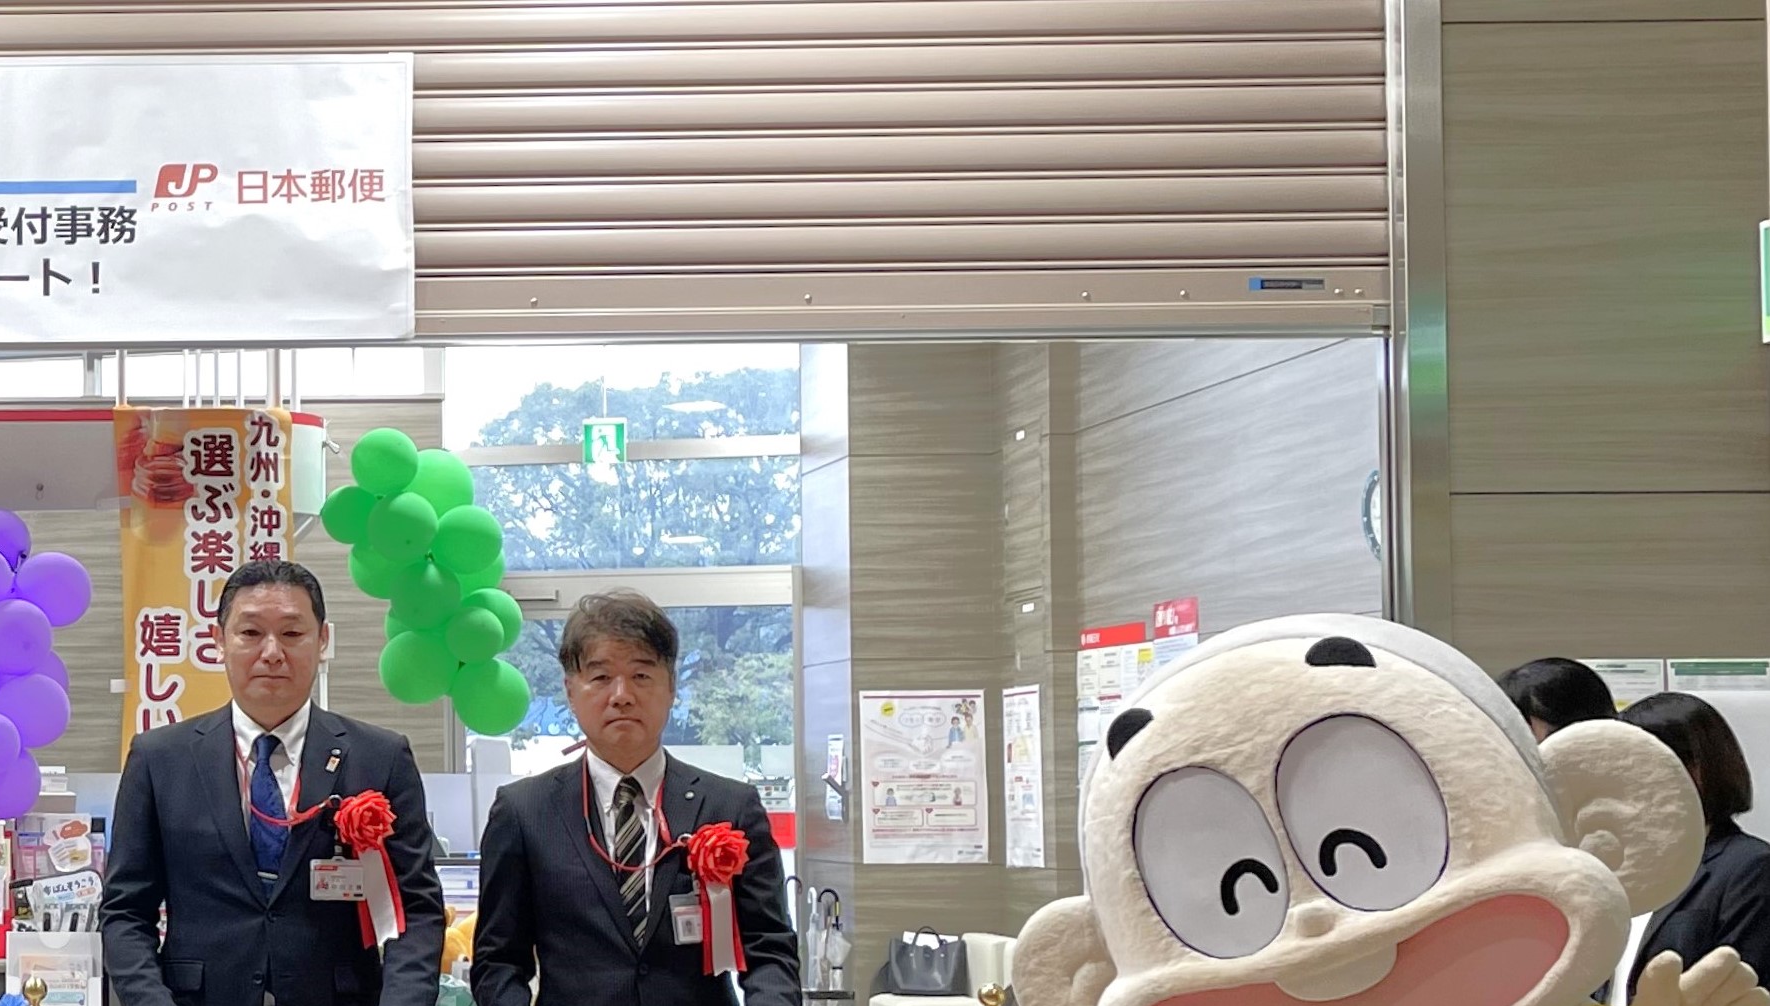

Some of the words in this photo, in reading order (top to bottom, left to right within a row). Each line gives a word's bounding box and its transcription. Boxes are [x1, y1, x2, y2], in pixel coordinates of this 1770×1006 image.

[237, 168, 385, 204] 日本郵便
[151, 201, 213, 212] POST
